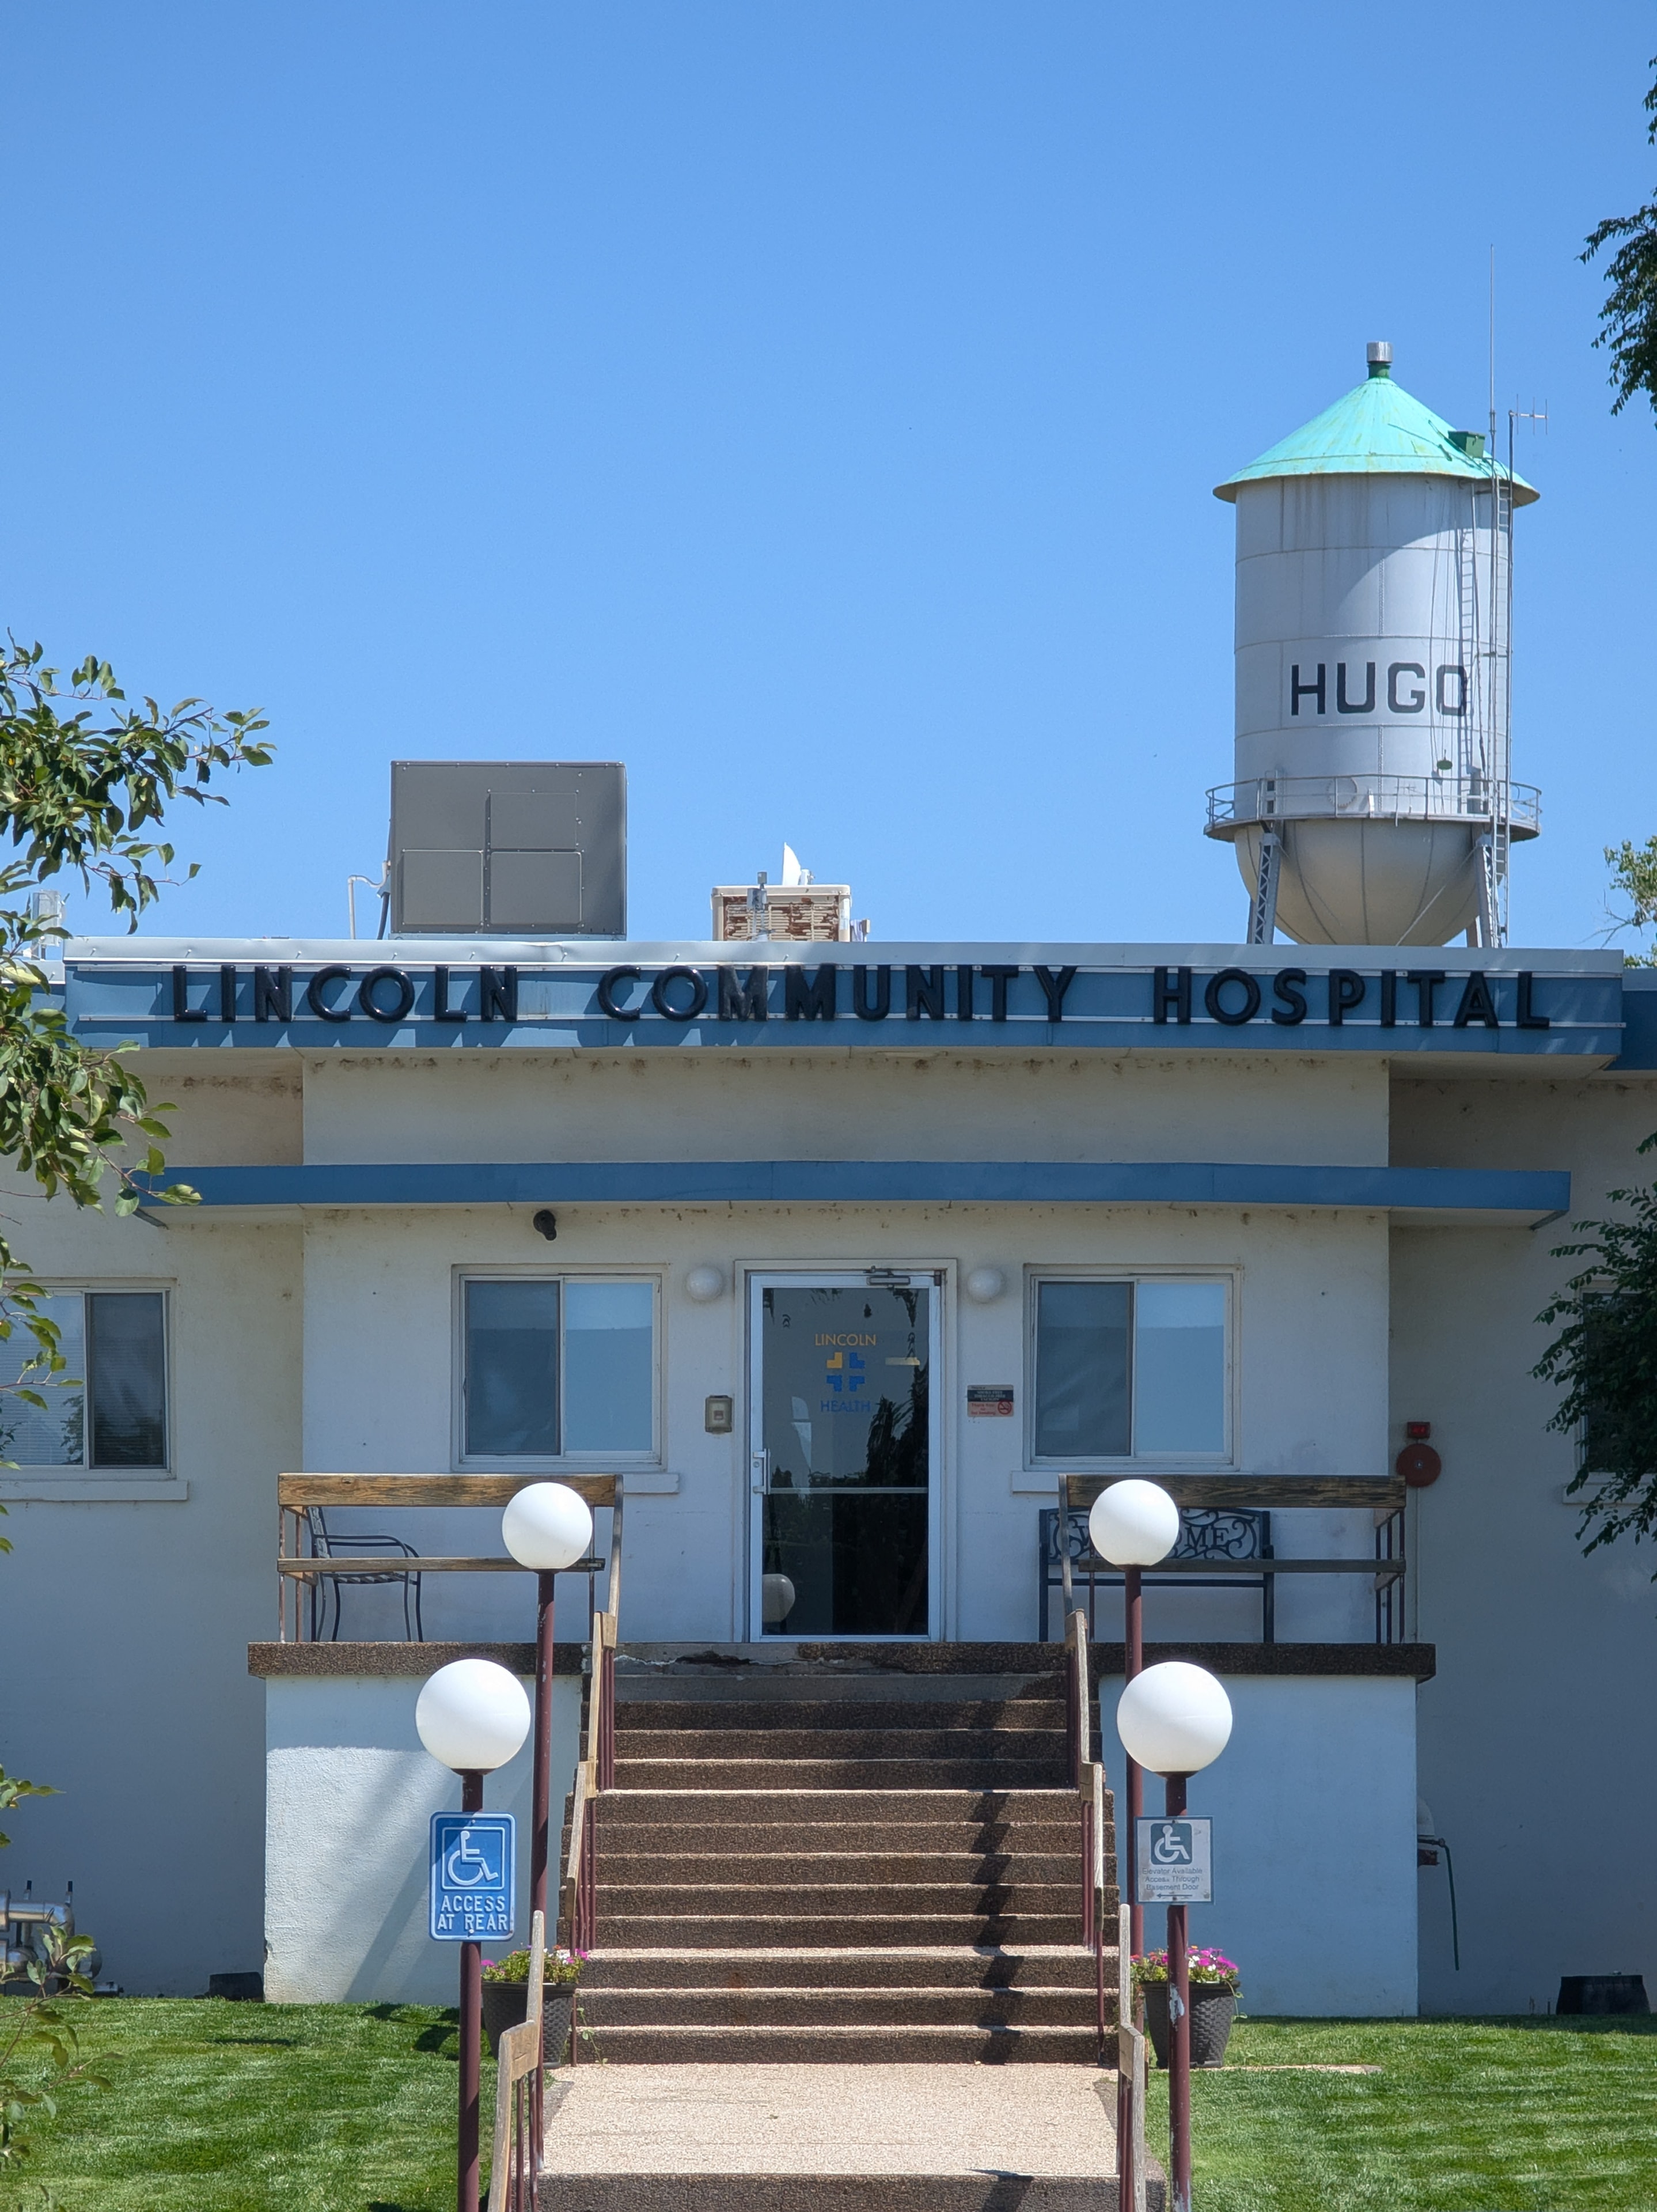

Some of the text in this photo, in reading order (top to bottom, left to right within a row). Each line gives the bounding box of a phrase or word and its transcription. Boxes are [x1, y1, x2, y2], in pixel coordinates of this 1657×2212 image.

[1291, 662, 1468, 716] HUGO
[172, 963, 1550, 1029] LINCOLN COMMUNITY HOSPITAL
[815, 1334, 877, 1346] LINCOLN
[820, 1400, 870, 1412] HEALTH
[441, 1895, 505, 1912] ACCESS
[437, 1914, 507, 1930] AT REAR
